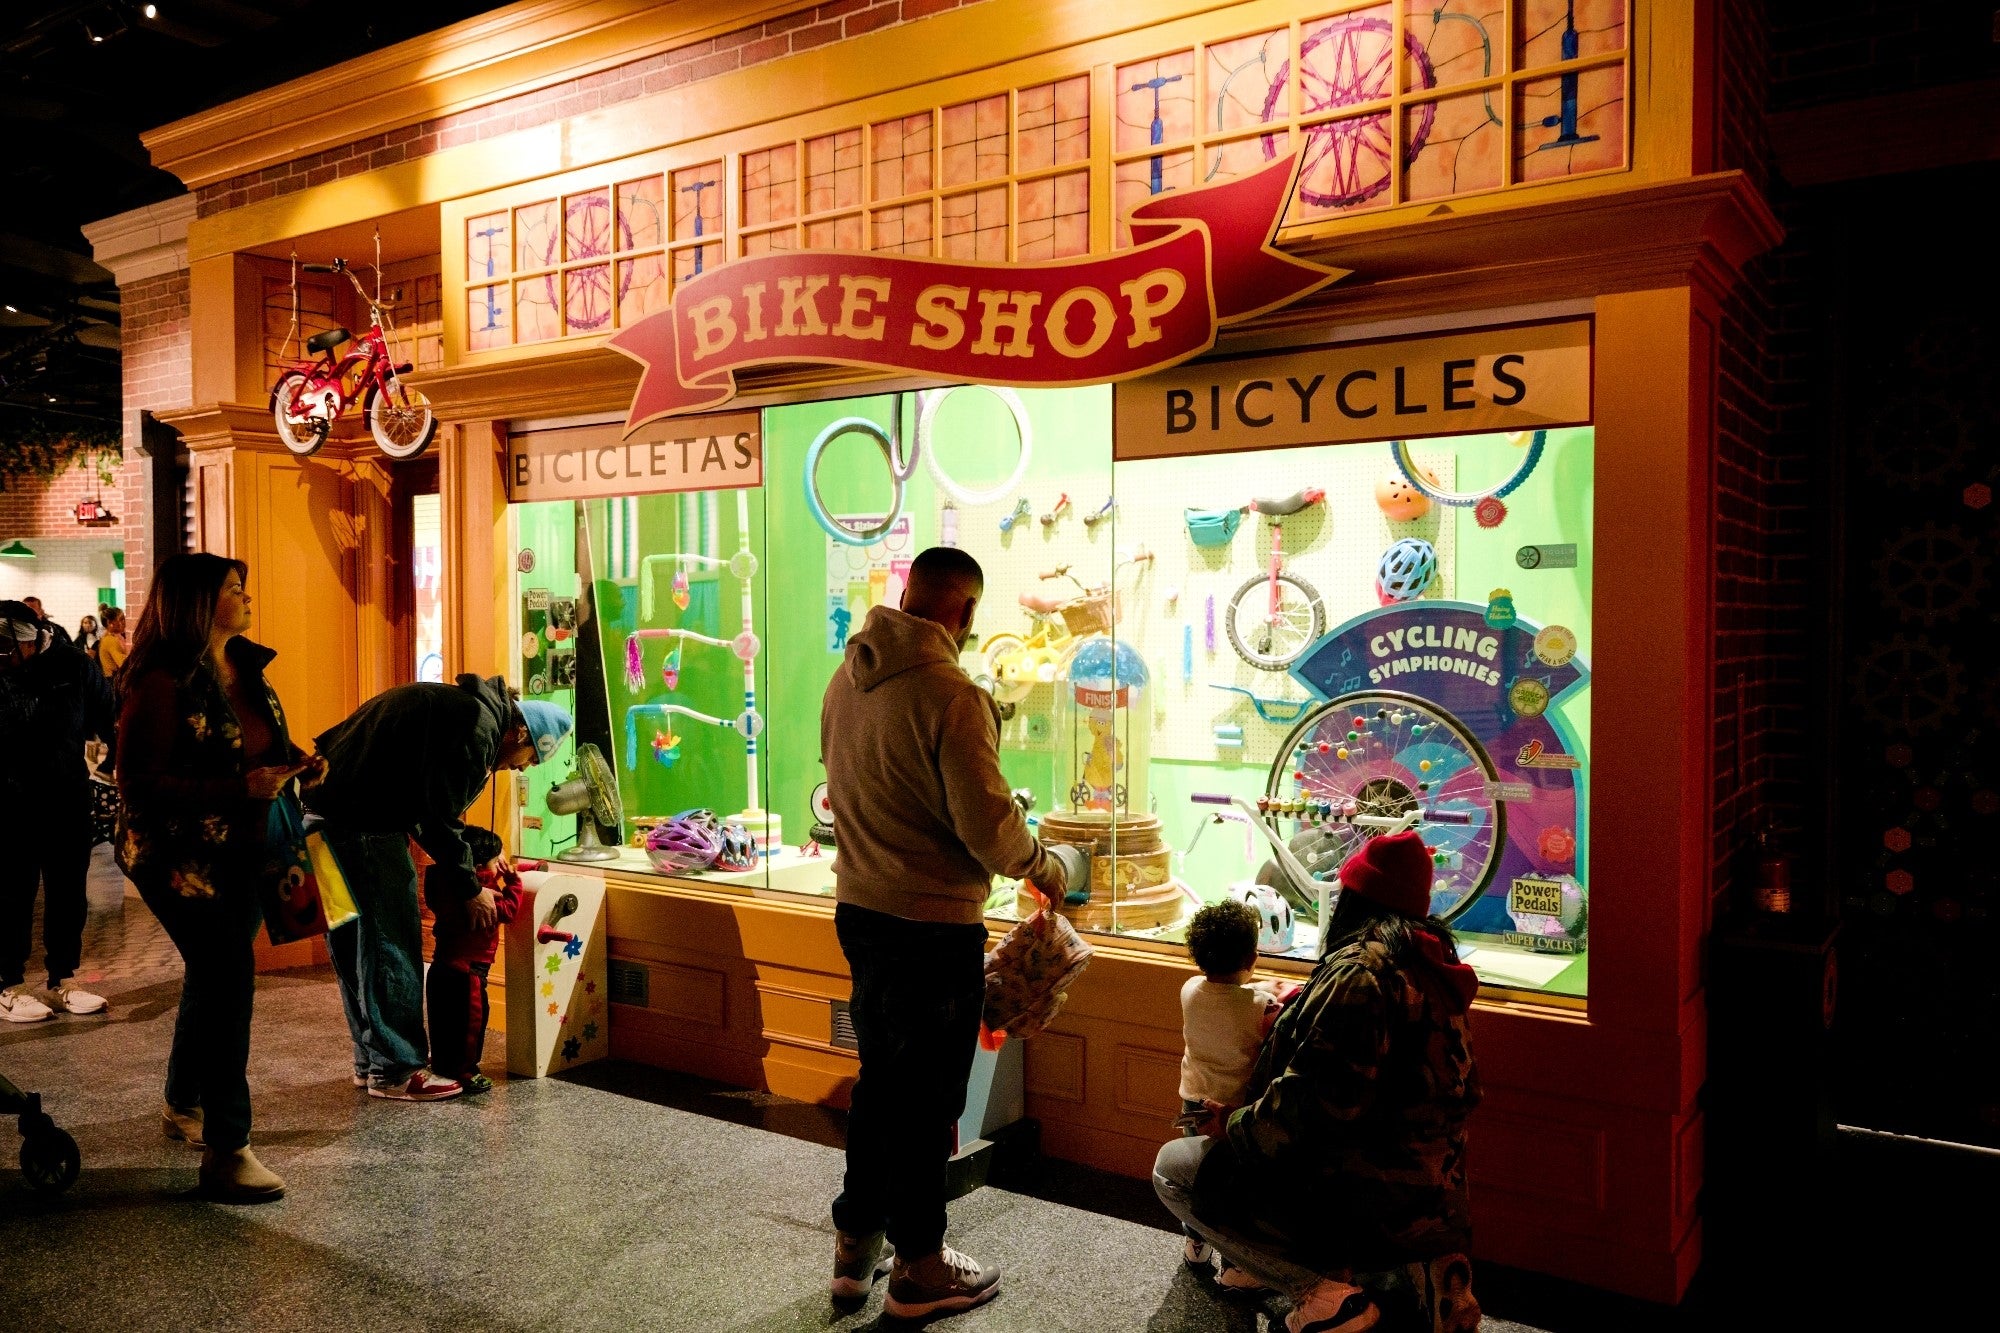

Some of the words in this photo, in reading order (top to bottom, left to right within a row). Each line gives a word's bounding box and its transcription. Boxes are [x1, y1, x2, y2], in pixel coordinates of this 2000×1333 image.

[688, 274, 892, 361] BIKE
[910, 268, 1188, 358] SHOP
[1166, 354, 1527, 435] BICYCLES
[515, 432, 752, 487] BICICLETAS
[529, 590, 547, 599] Power
[1370, 625, 1499, 661] CYCLING
[1368, 655, 1501, 687] SYMPHONIES
[1515, 882, 1559, 898] Power
[1515, 895, 1559, 912] Pedals
[1506, 932, 1535, 947] SUPER
[1537, 937, 1573, 952] CYCLES
